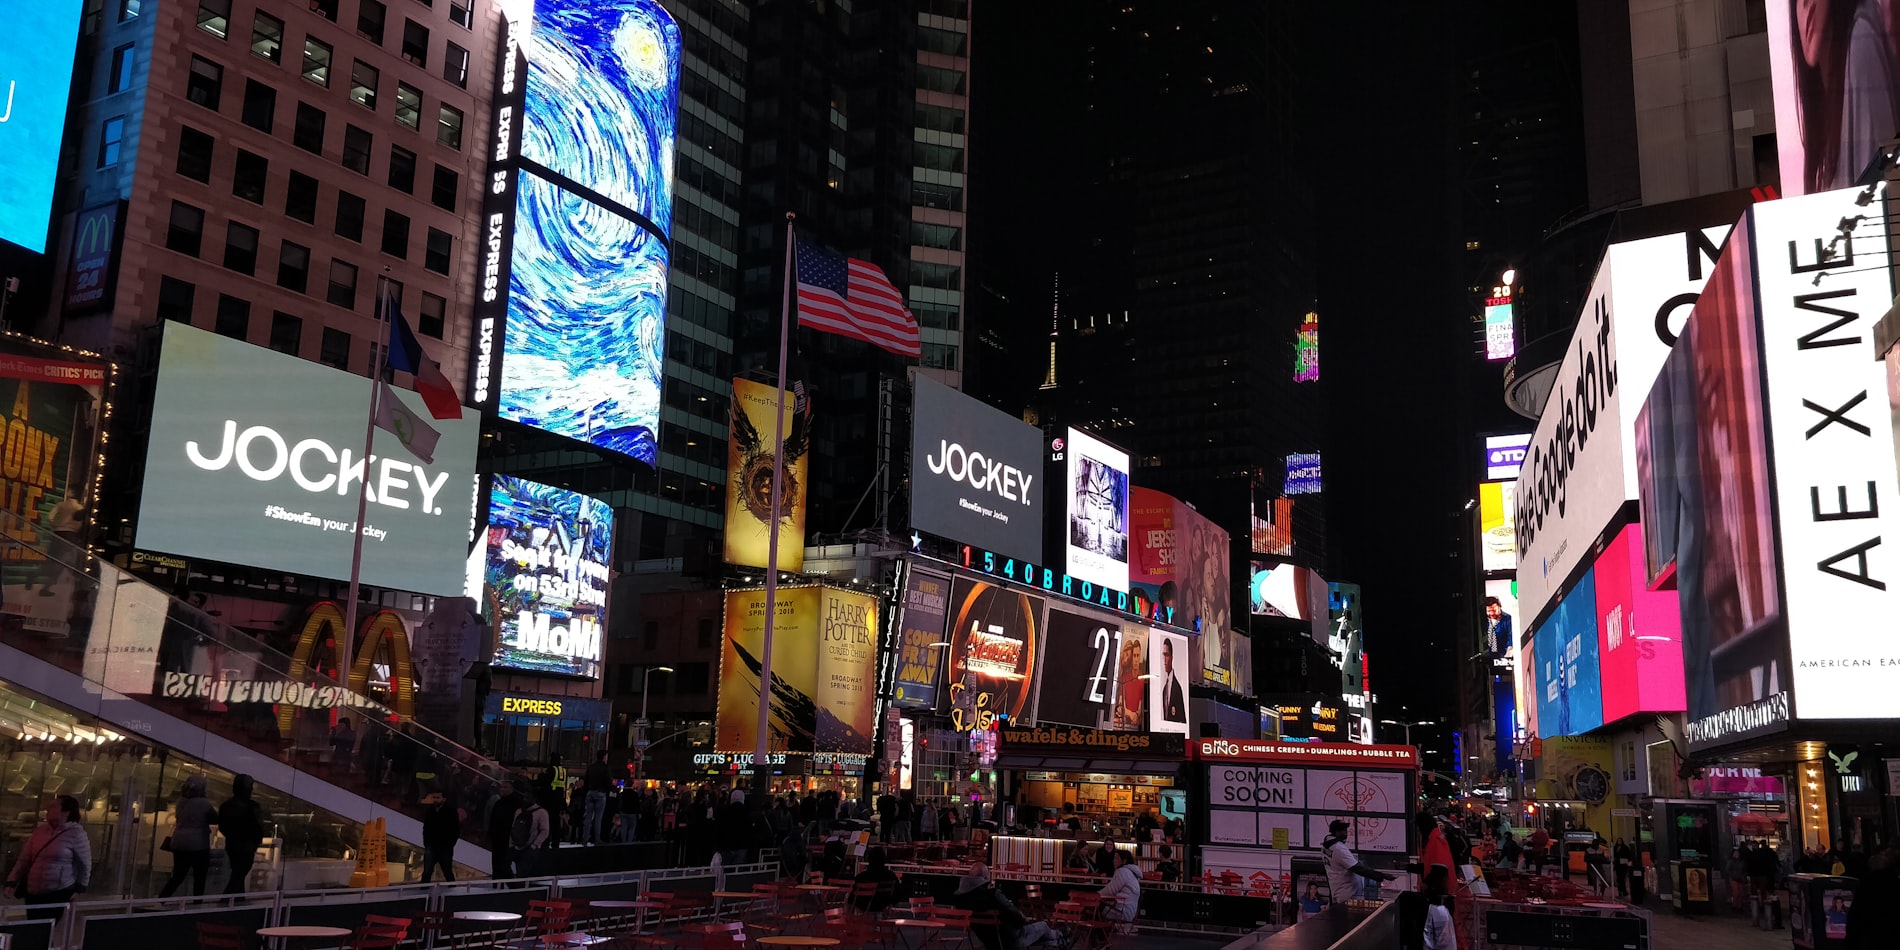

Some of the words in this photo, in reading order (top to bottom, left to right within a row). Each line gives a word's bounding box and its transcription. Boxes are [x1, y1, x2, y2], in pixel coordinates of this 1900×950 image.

[483, 212, 504, 303] EXPRESS
[474, 317, 495, 403] EXPRESS
[1801, 389, 1872, 441] X
[1533, 384, 1576, 519] Google
[1576, 337, 1596, 453] do
[1052, 452, 1064, 461] LG
[927, 438, 1033, 506] JOCKEY.
[264, 504, 321, 528] #ShowEm
[323, 517, 349, 539] your
[349, 521, 387, 542] Jckey
[750, 600, 793, 608] BROWAY
[829, 597, 871, 627] HARRY
[516, 610, 600, 662] MoMA
[824, 617, 872, 646] POTTER
[905, 628, 940, 650] COME
[1799, 658, 1871, 668] AMERICAN
[831, 674, 862, 683] BROADWAY
[899, 662, 936, 685] AWAY
[830, 682, 850, 690] SPRING
[503, 696, 562, 715] EXPRESS
[693, 753, 726, 764] GIFTS
[733, 753, 786, 765] LUGAGE
[813, 753, 833, 764] GIFTS
[836, 753, 867, 765] LUGGAGE
[1242, 745, 1275, 753] CHINESE
[1277, 746, 1305, 754] CREPES
[1310, 747, 1358, 756] DUMPLINGS
[1362, 749, 1393, 757] BUBBLE
[1224, 769, 1293, 784] COMING
[1224, 785, 1293, 804] SOON!
